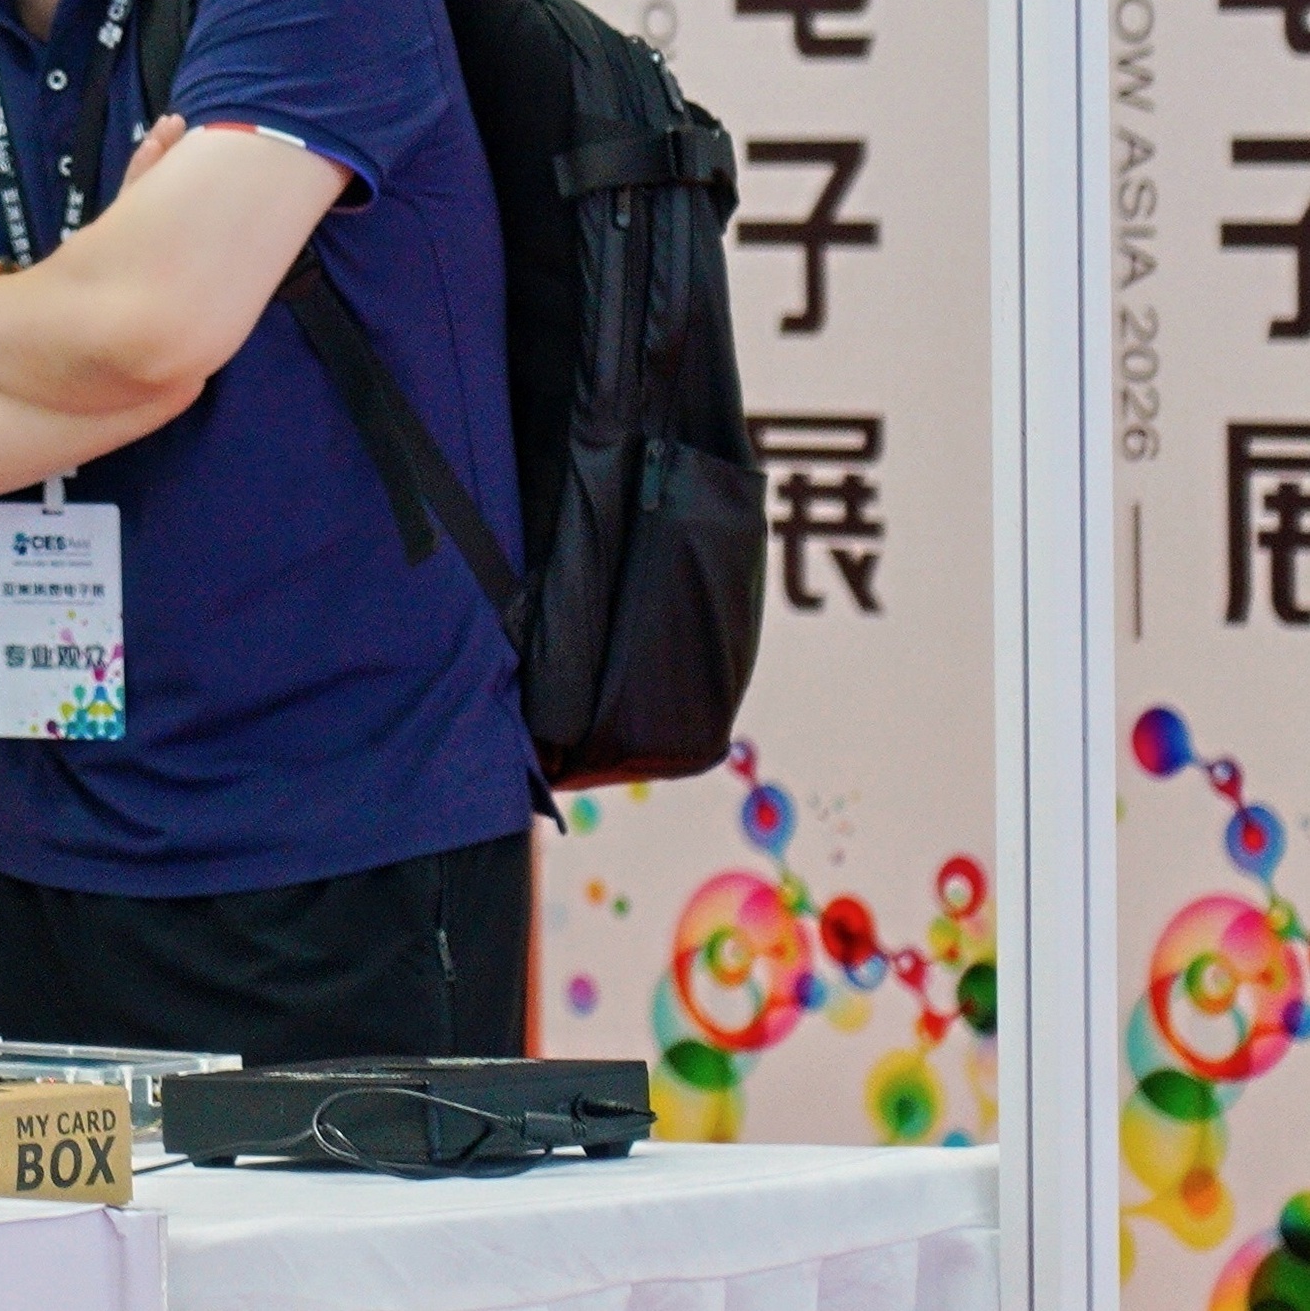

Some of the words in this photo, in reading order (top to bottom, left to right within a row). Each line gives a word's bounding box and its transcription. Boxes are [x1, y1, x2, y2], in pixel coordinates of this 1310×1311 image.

[1117, 126, 1159, 290] ASIA
[1120, 305, 1162, 463] 2026
[16, 1114, 49, 1139] MY
[57, 1108, 117, 1136] CARD
[16, 1136, 116, 1192] BOX
